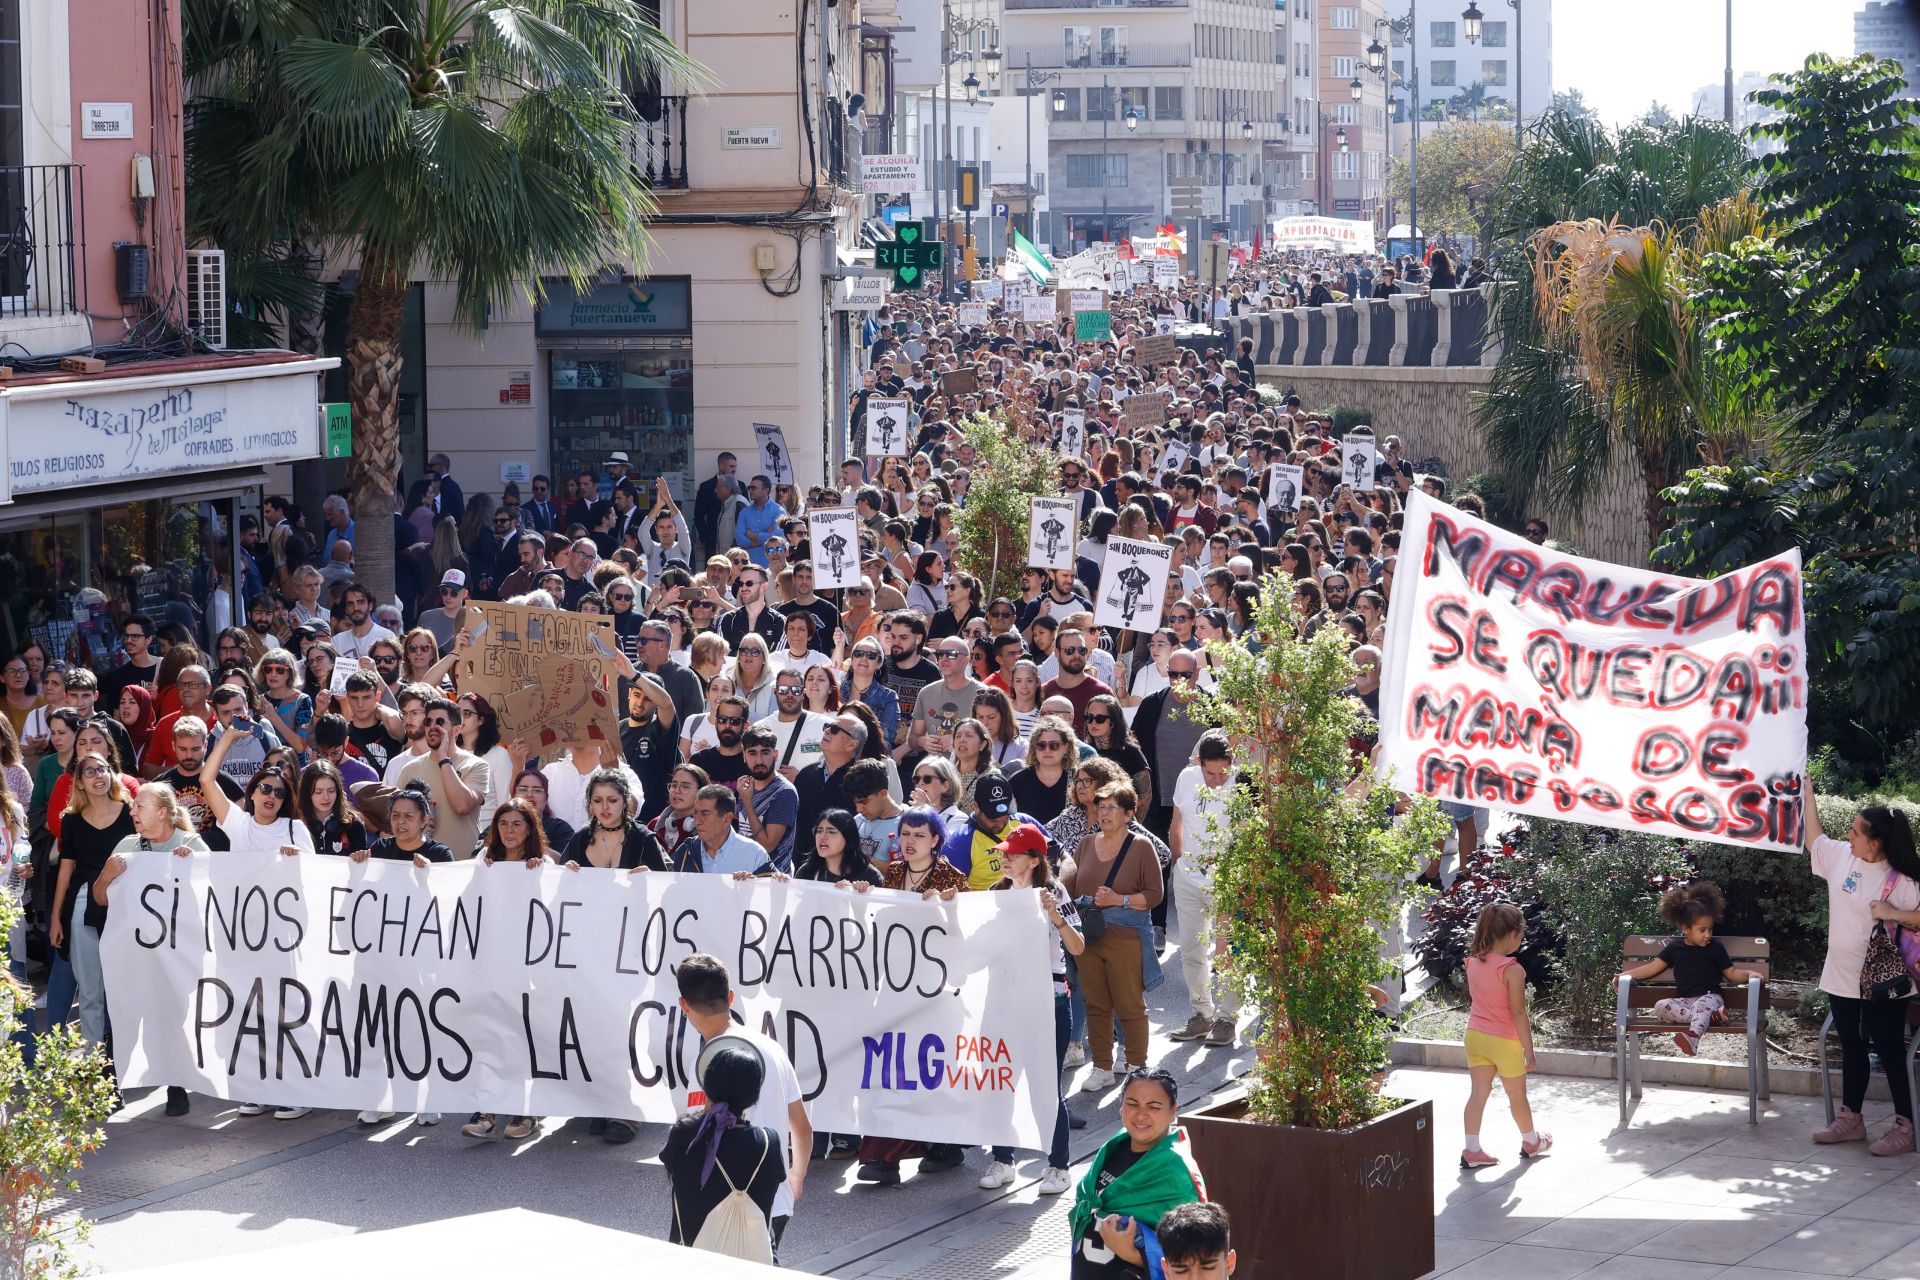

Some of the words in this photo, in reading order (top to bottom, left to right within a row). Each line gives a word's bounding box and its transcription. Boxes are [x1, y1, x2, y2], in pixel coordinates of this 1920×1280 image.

[996, 205, 1006, 217] P
[569, 313, 656, 327] puertanueva
[571, 302, 630, 314] farmacia
[331, 416, 348, 431] ATM
[44, 453, 105, 474] RELIGIOSOS
[812, 514, 820, 523] SIN
[821, 511, 854, 524] BOQUERONES
[1042, 500, 1074, 511] BOQUERONES
[1109, 542, 1120, 554] SIN
[1122, 543, 1169, 559] BOQUERONES
[1424, 511, 1799, 636] MAQUEDA
[485, 609, 521, 650] EL
[528, 613, 604, 655] HOGAR
[1426, 594, 1508, 677] SE
[484, 647, 506, 677] ES
[508, 651, 528, 678] UN
[1632, 721, 1755, 787] DE
[205, 885, 304, 952] NOS
[328, 886, 483, 961] ECHAN
[525, 898, 583, 969] DE
[616, 906, 699, 976] LOS
[195, 977, 473, 1083] PARAMOS
[522, 993, 592, 1082] LA
[861, 1032, 945, 1091] MLG
[955, 1034, 1011, 1064] PARA
[946, 1066, 1015, 1094] VIVIR
